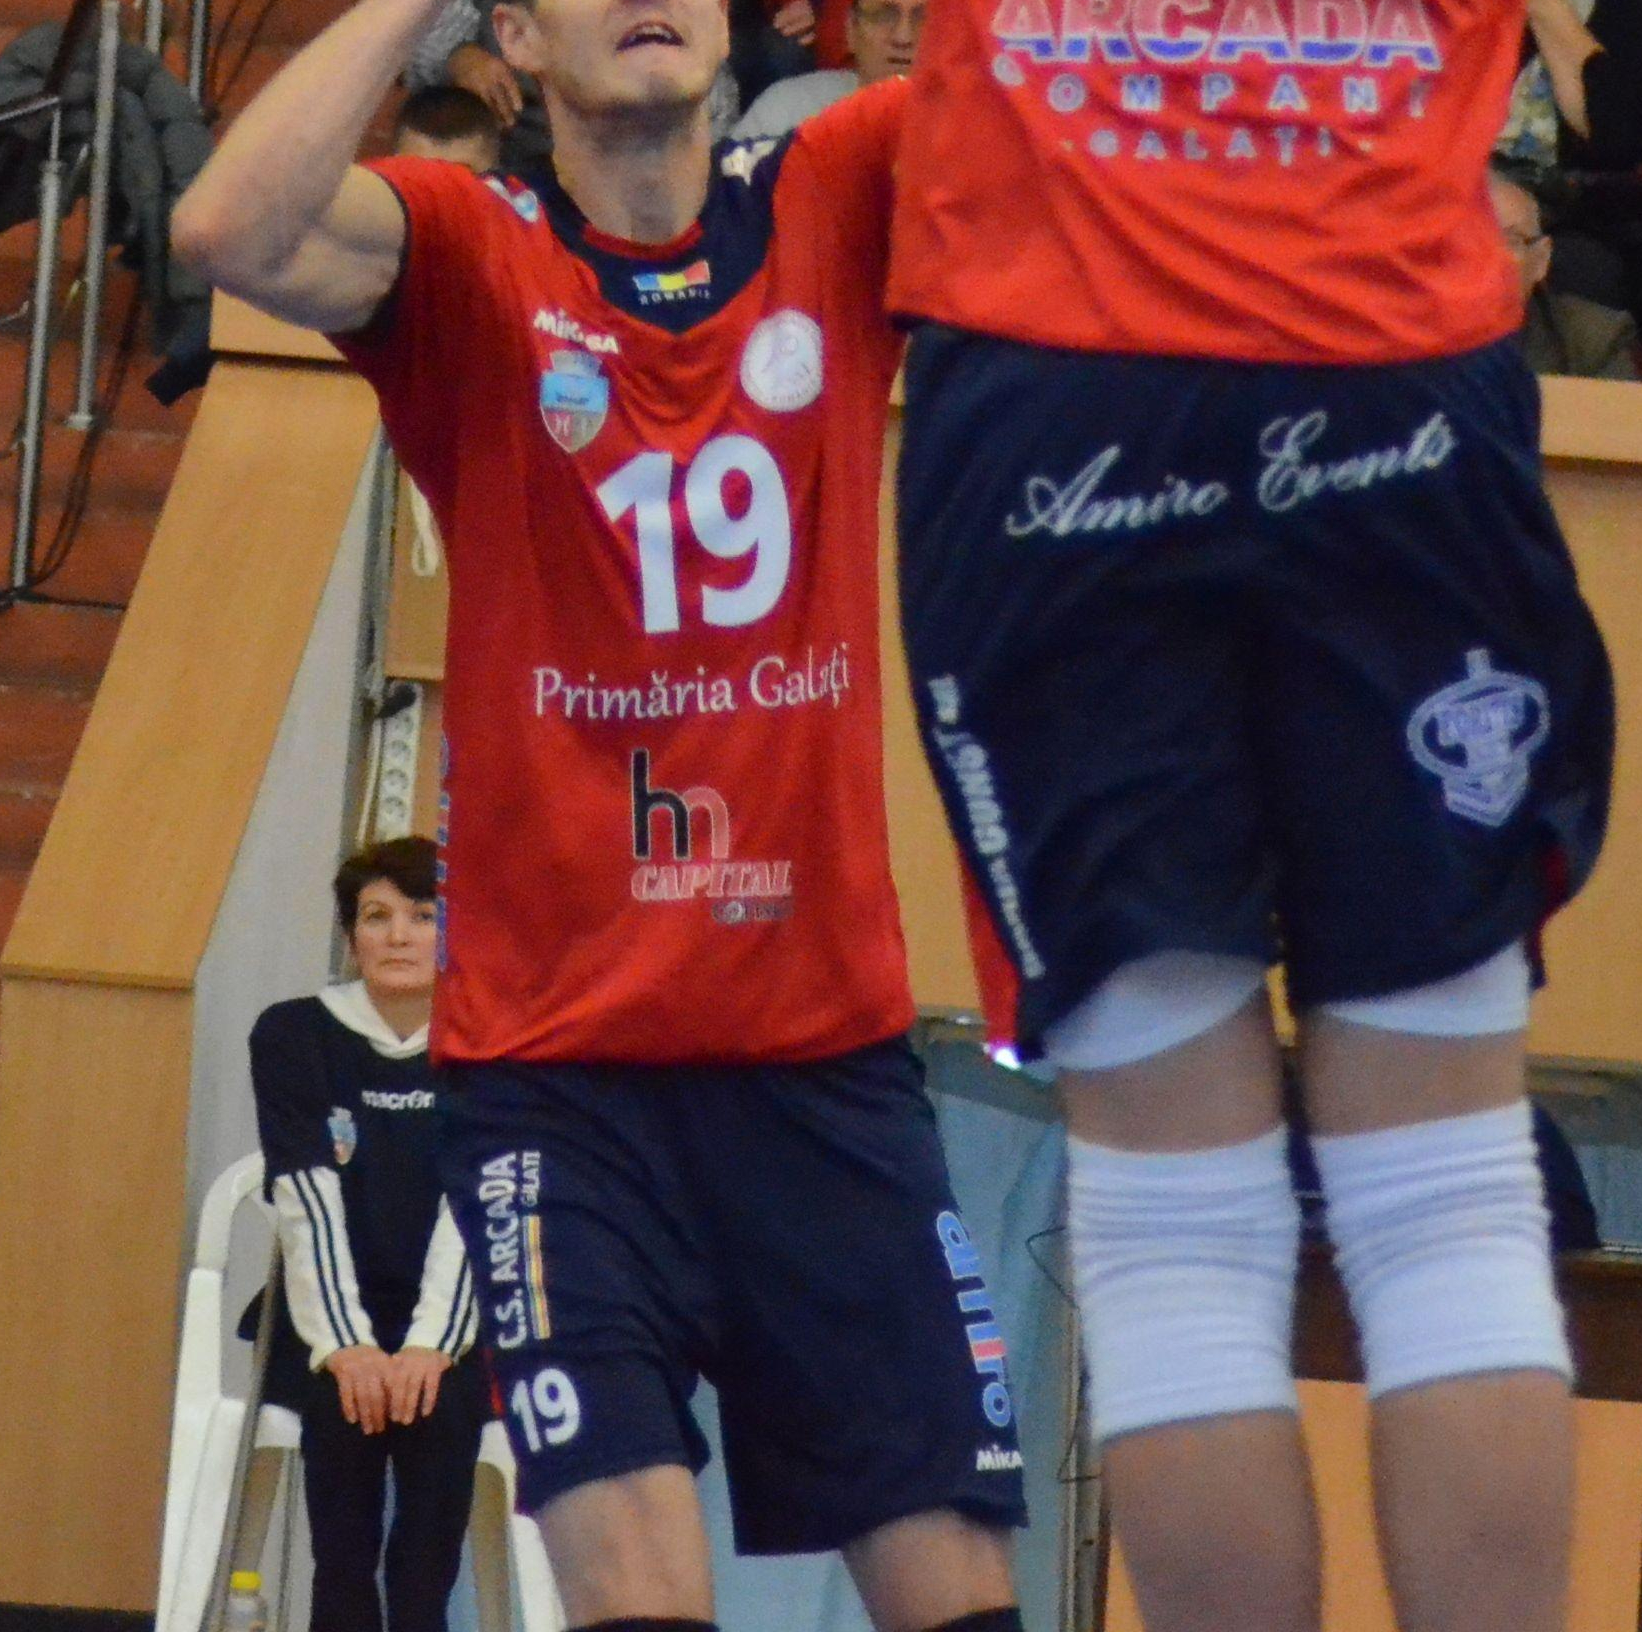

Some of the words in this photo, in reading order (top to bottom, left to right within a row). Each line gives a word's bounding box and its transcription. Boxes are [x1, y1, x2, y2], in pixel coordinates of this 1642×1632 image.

[1004, 444, 1232, 537] Amiro
[1259, 409, 1456, 512] Events
[596, 433, 792, 634] 19
[533, 664, 738, 720] Primăria
[631, 860, 793, 902] CAPITAL
[478, 1152, 519, 1282] ARCADA
[495, 1288, 528, 1350] C.S.
[511, 1368, 581, 1454] 19
